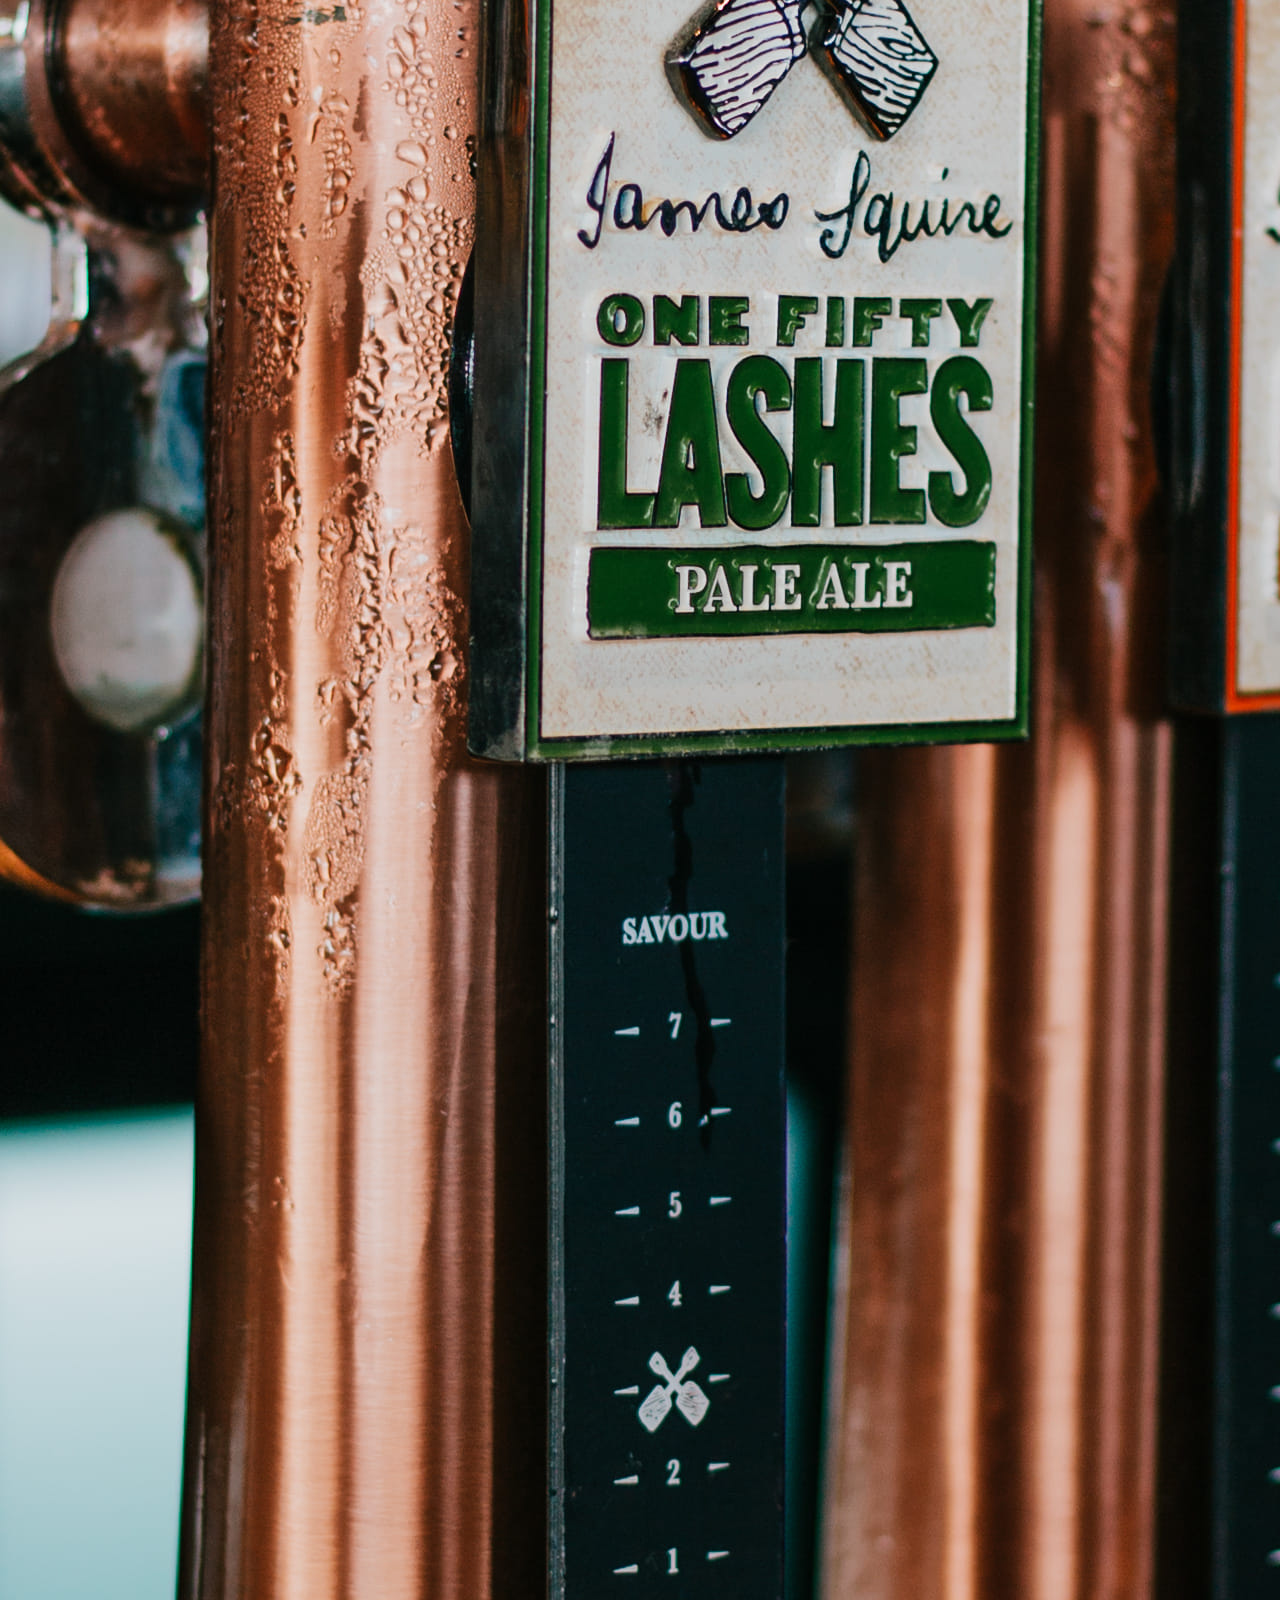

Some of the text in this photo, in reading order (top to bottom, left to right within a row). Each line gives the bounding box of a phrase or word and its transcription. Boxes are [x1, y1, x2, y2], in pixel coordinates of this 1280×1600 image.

[577, 130, 1013, 264] James Squire
[596, 292, 995, 348] ONE FIFTY
[595, 354, 994, 533] LASHES
[674, 559, 914, 614] PALE ALE
[622, 911, 729, 945] SAVOUR
[668, 1012, 682, 1039] 7
[668, 1102, 682, 1128] 6
[668, 1192, 682, 1218] 5
[668, 1281, 682, 1307] 4
[666, 1459, 681, 1486] 2
[666, 1548, 680, 1574] 1
